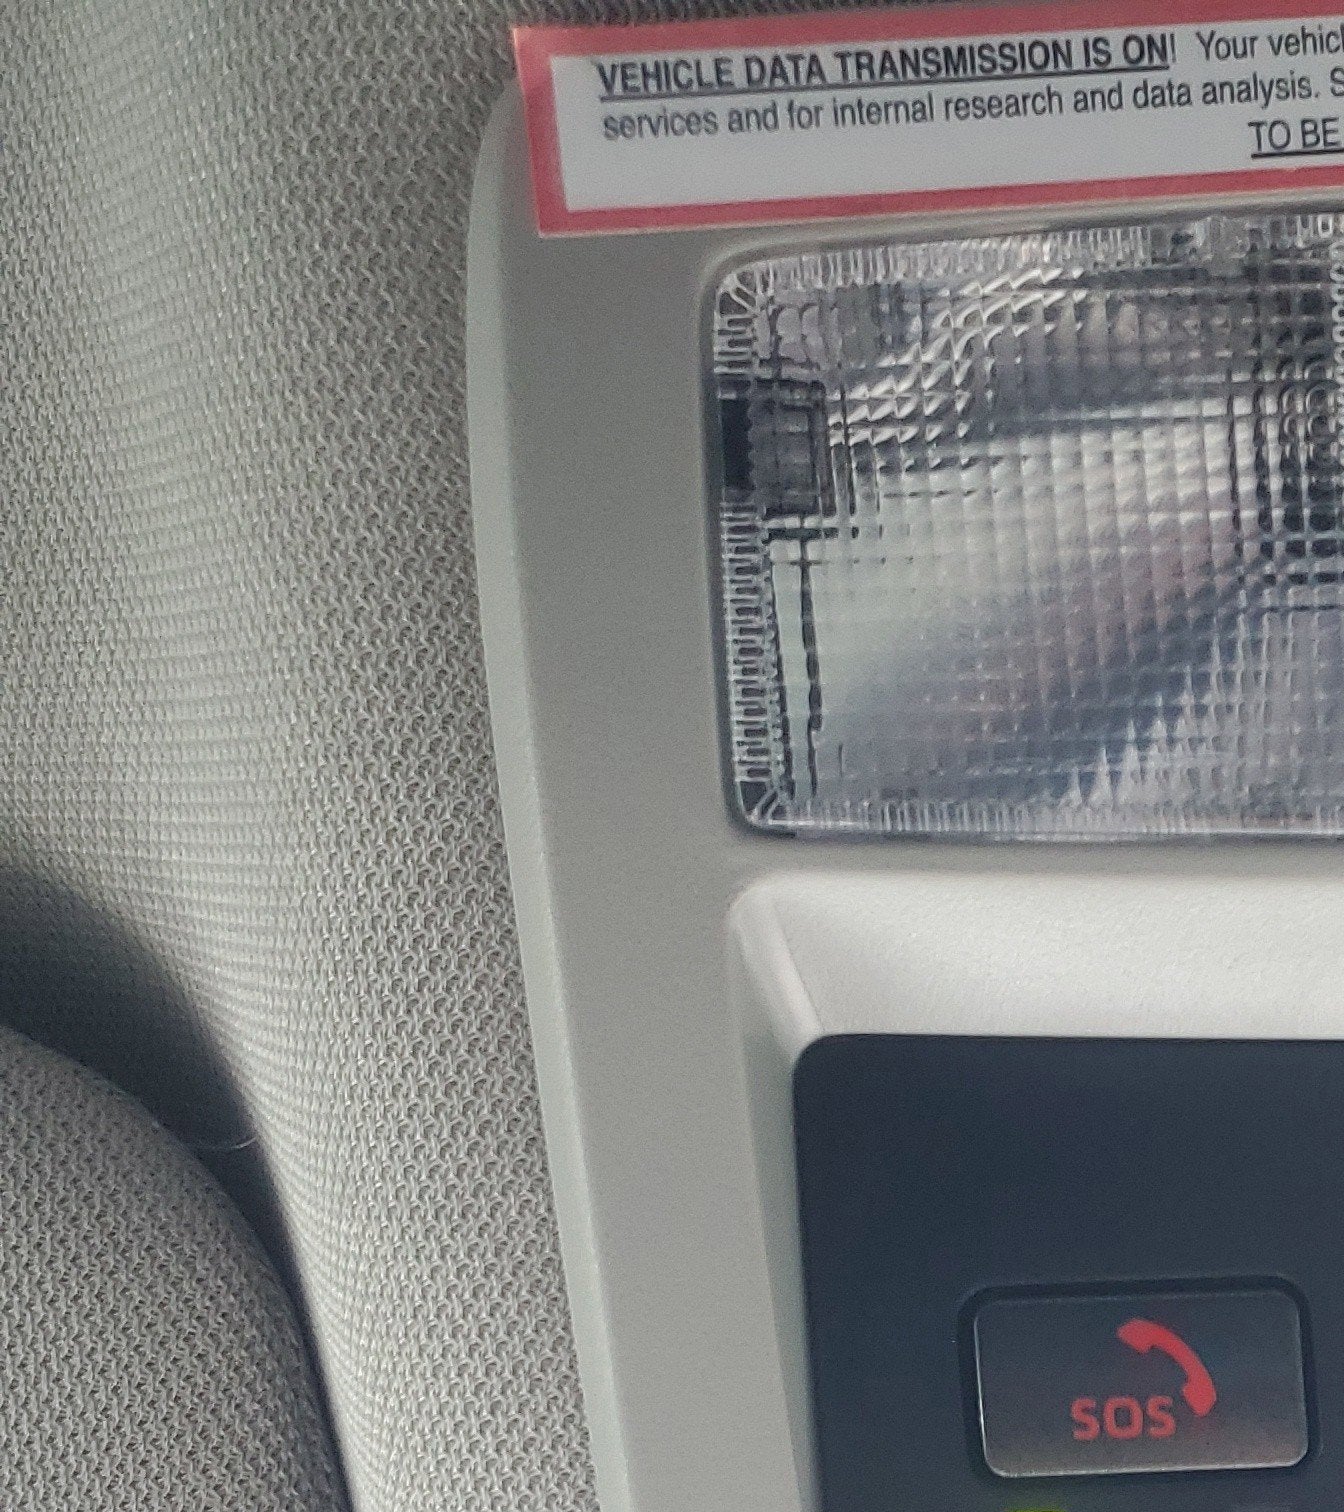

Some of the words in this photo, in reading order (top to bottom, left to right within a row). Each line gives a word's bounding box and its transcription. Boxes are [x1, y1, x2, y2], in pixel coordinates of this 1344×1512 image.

[597, 57, 734, 94] VEHICLE
[744, 52, 827, 88] DATA
[834, 39, 1073, 81] TRANSMISSION
[1083, 36, 1112, 68] IS
[1122, 33, 1176, 64] ON!
[1196, 30, 1258, 60] Your
[603, 105, 719, 140] services
[728, 99, 780, 133] and
[788, 99, 824, 130] for
[832, 91, 934, 126] internal
[944, 84, 1063, 120] research
[1073, 80, 1123, 113] and
[1132, 78, 1193, 109] data
[1201, 70, 1320, 109] analysis.
[1248, 119, 1292, 151] TO
[1300, 116, 1341, 149] BE
[1069, 1396, 1177, 1441] SOS
